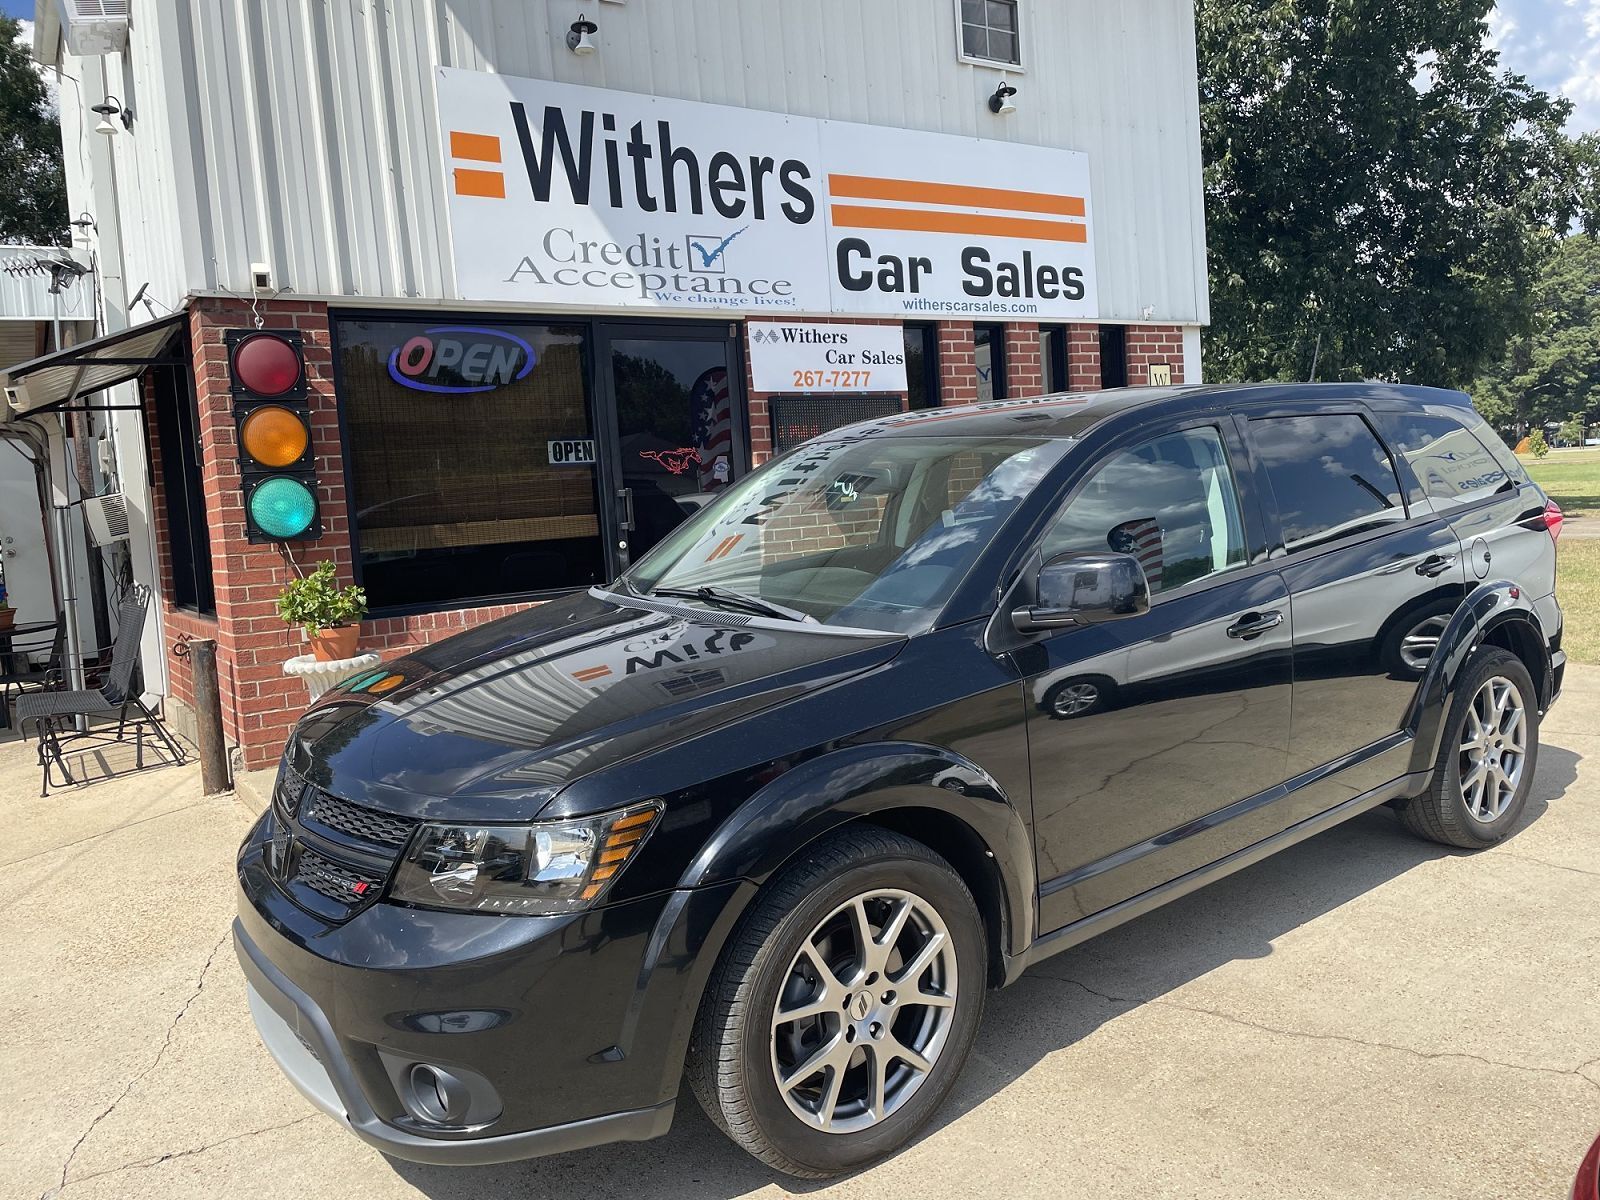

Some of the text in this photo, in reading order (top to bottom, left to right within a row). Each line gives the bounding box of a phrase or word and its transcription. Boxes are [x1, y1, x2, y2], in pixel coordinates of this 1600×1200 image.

[509, 101, 815, 225] Withers
[542, 227, 683, 271] Credit
[502, 255, 793, 299] Acceptance
[836, 237, 1086, 301] Car Sales
[654, 291, 797, 307] We change lives!
[902, 297, 1038, 314] witherscarsales.com
[780, 327, 848, 344] Withers
[399, 336, 521, 385] OPEN
[825, 349, 904, 365] Car Sales
[792, 370, 871, 387] 267-7277
[552, 441, 594, 462] OPEN
